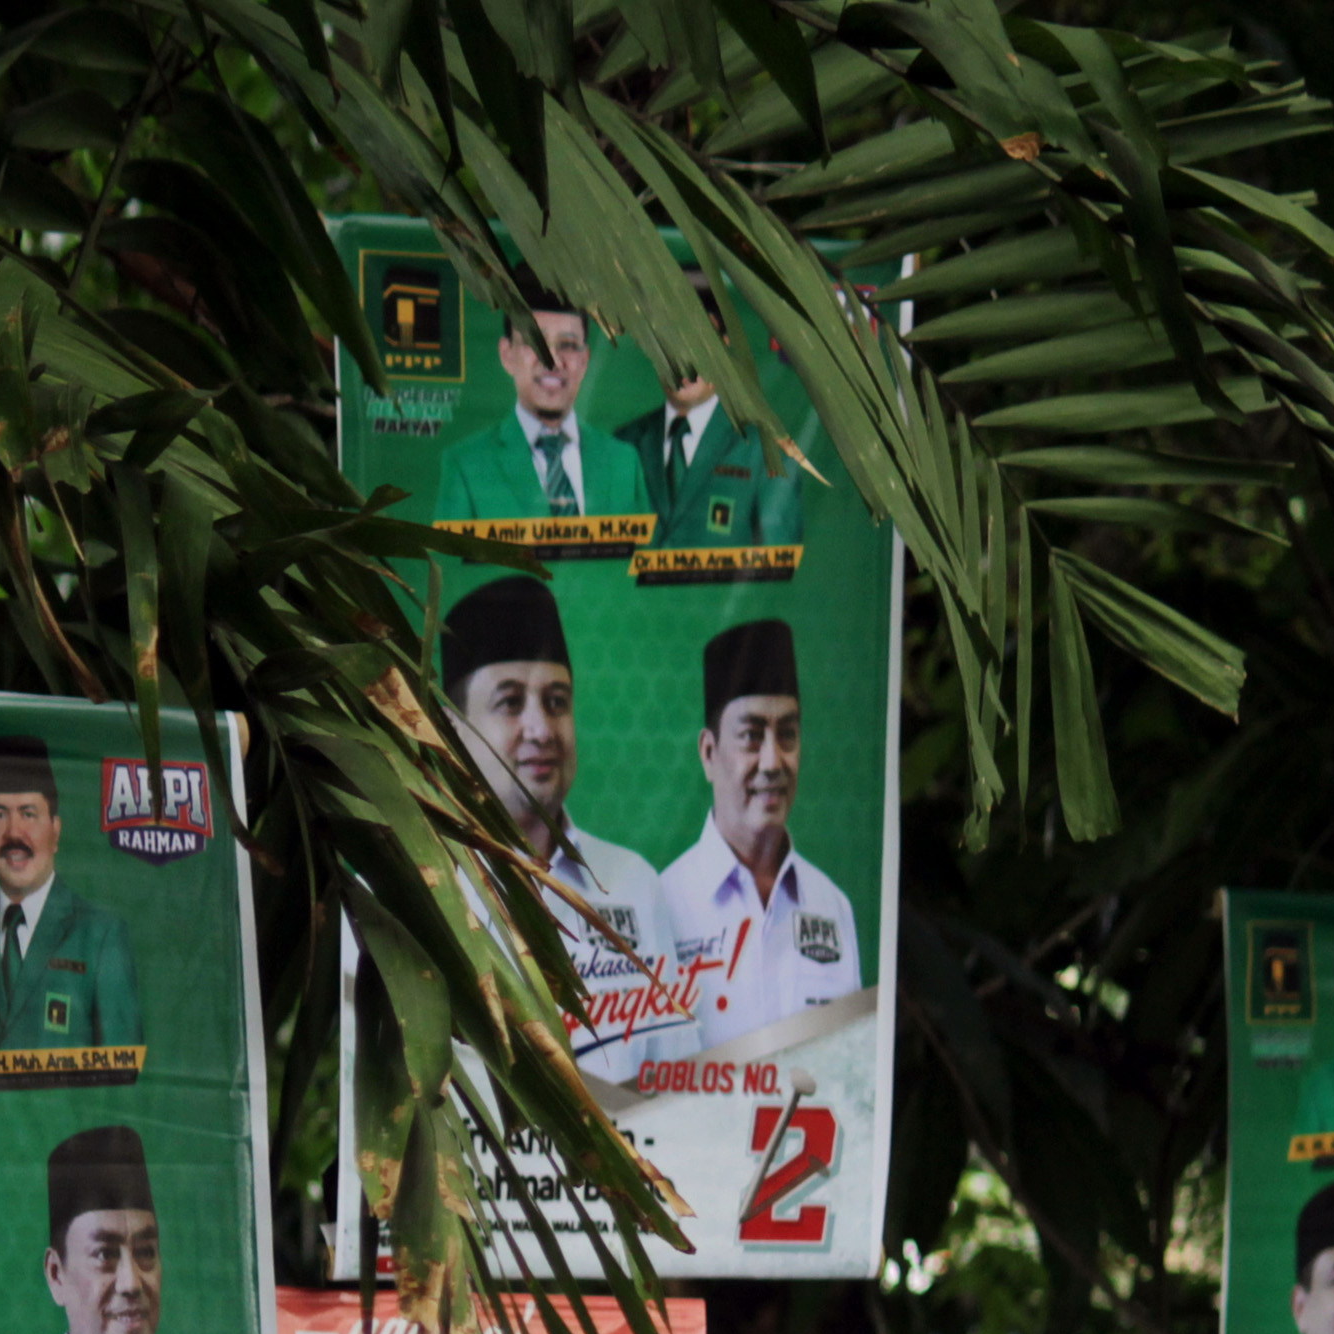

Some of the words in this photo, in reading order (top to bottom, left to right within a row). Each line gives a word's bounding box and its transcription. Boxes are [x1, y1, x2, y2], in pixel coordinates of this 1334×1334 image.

[119, 830, 196, 854] RAHMAN
[799, 916, 838, 947] APPI
[638, 1060, 735, 1094] COBLOS
[743, 1064, 782, 1095] NO.
[739, 1106, 837, 1242] 2
